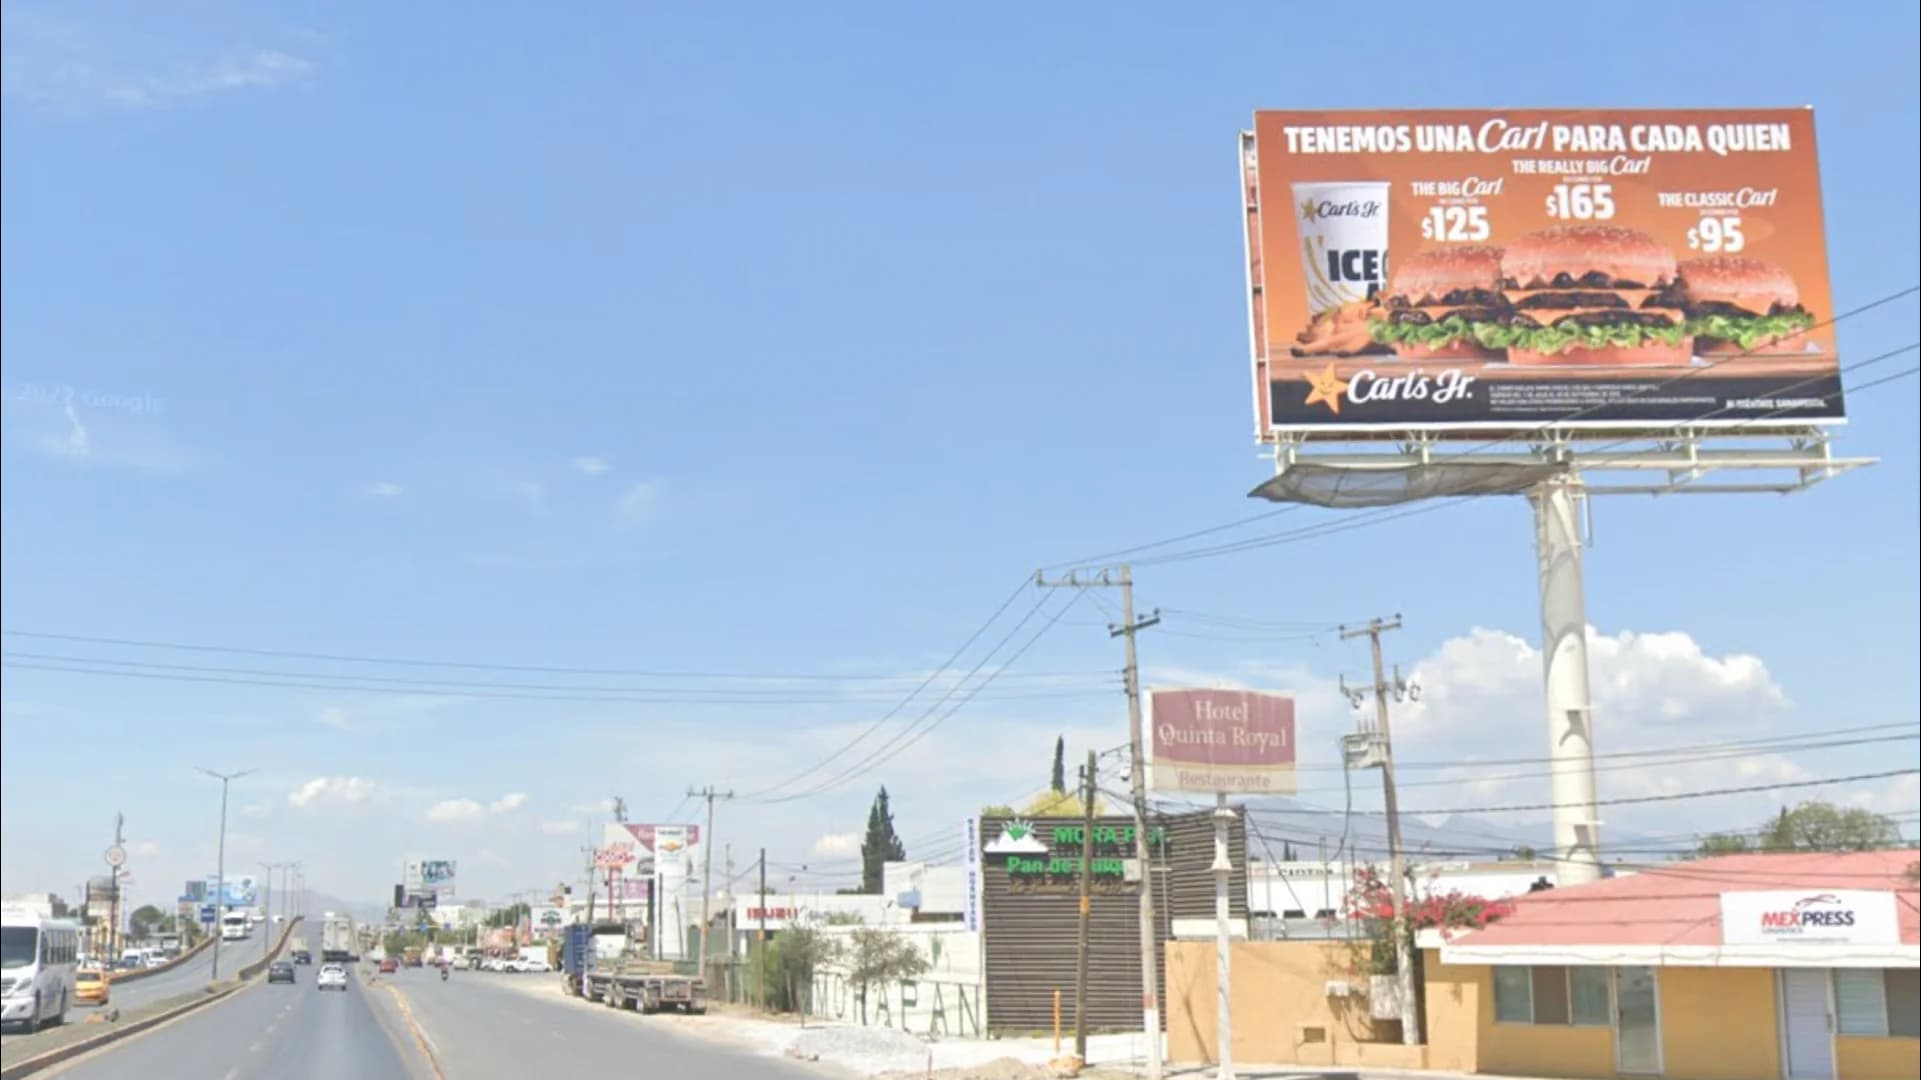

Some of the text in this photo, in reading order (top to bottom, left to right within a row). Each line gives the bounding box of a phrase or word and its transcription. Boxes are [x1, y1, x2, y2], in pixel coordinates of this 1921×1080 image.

[1284, 118, 1791, 155] TENEMOS UNA Carl PARA CADA QUIEN
[1512, 155, 1651, 176] THE REALLY BIG Carl
[1411, 176, 1504, 197] THE BIG Carl
[1657, 186, 1778, 208] THE CLASSIC Carl
[1318, 200, 1359, 218] Carl's
[1545, 184, 1615, 220] $165
[1421, 206, 1489, 242] $125
[1686, 216, 1744, 253] $95
[1347, 367, 1475, 404] Carl's Jr.
[1195, 699, 1248, 722] Hotel
[1159, 722, 1287, 754] Quinta Royal
[1177, 770, 1272, 787] Restaurante
[1054, 826, 1117, 843] MORA
[1007, 856, 1043, 874] Pan
[1049, 857, 1073, 874] de
[747, 907, 798, 920] ISUZU
[1762, 911, 1855, 927] MEXPRESS
